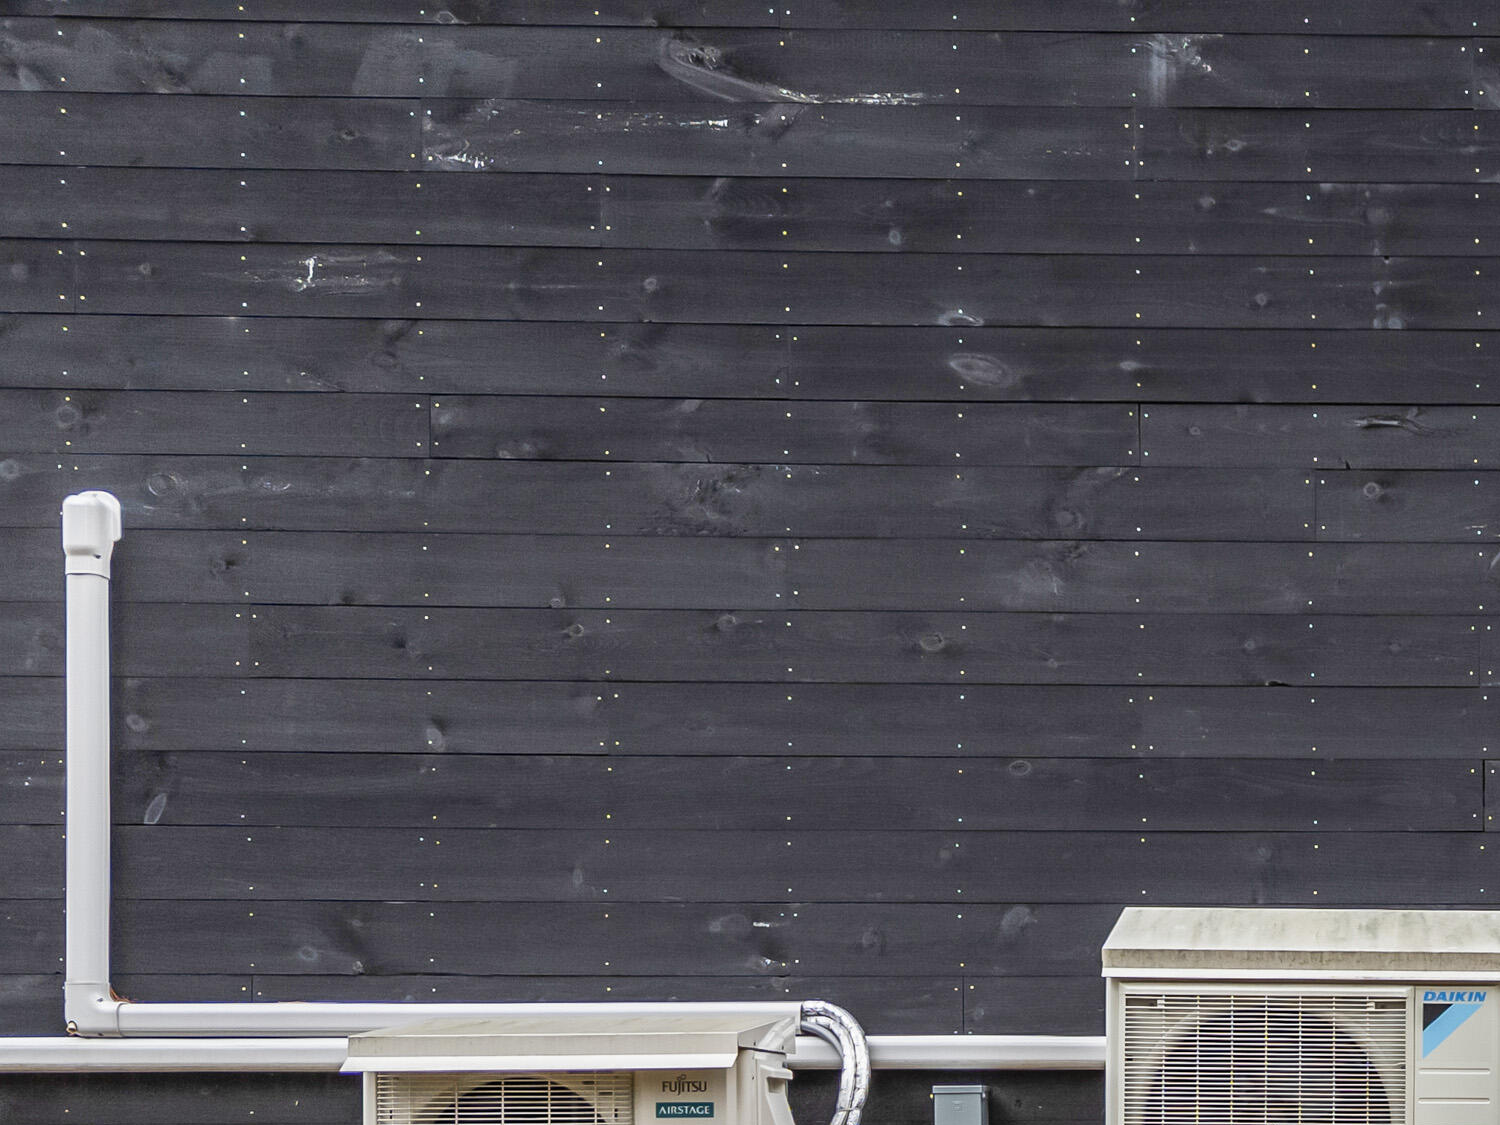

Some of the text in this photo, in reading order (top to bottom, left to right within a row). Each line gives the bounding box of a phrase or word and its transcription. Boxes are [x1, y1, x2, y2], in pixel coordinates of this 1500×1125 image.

[1424, 991, 1487, 1002] DAIKIN
[662, 1075, 708, 1096] FUJITSU
[659, 1105, 711, 1115] AIRSTAGE
